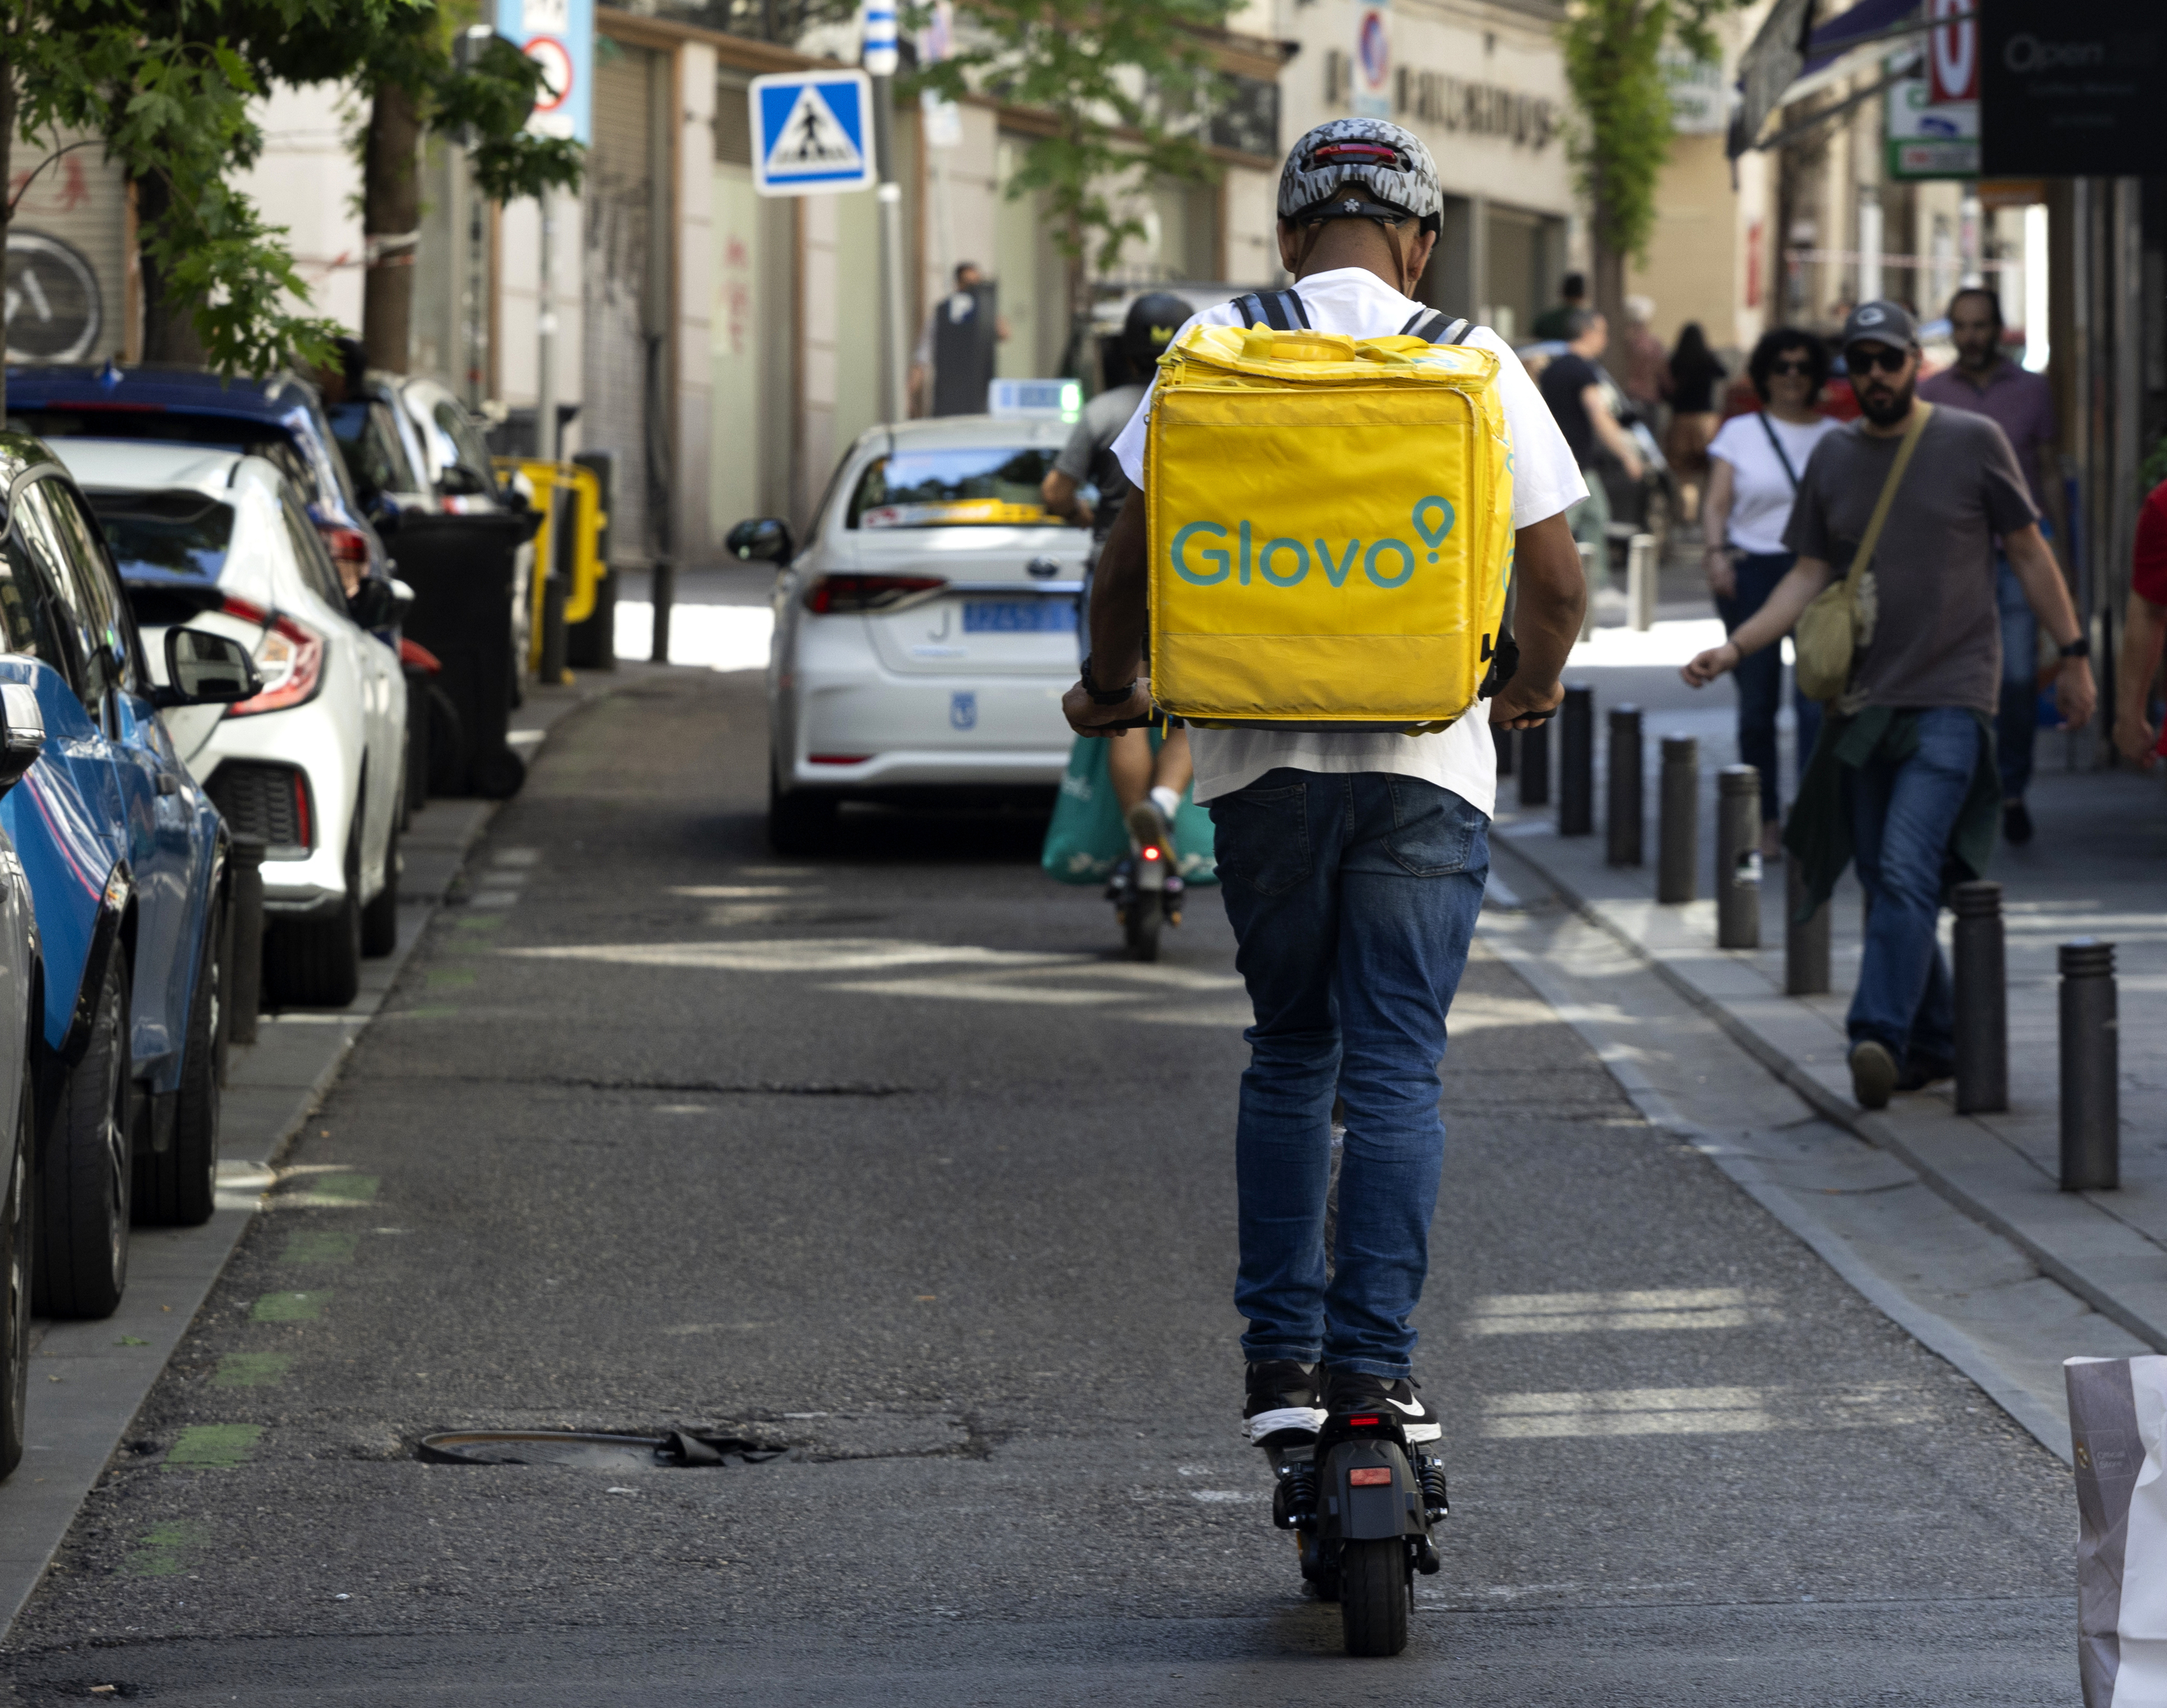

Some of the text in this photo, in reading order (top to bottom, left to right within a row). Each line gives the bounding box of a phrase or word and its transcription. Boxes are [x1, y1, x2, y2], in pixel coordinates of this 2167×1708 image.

[2003, 32, 2106, 73] Open
[1170, 519, 1415, 589] Glovo
[927, 605, 950, 643] J
